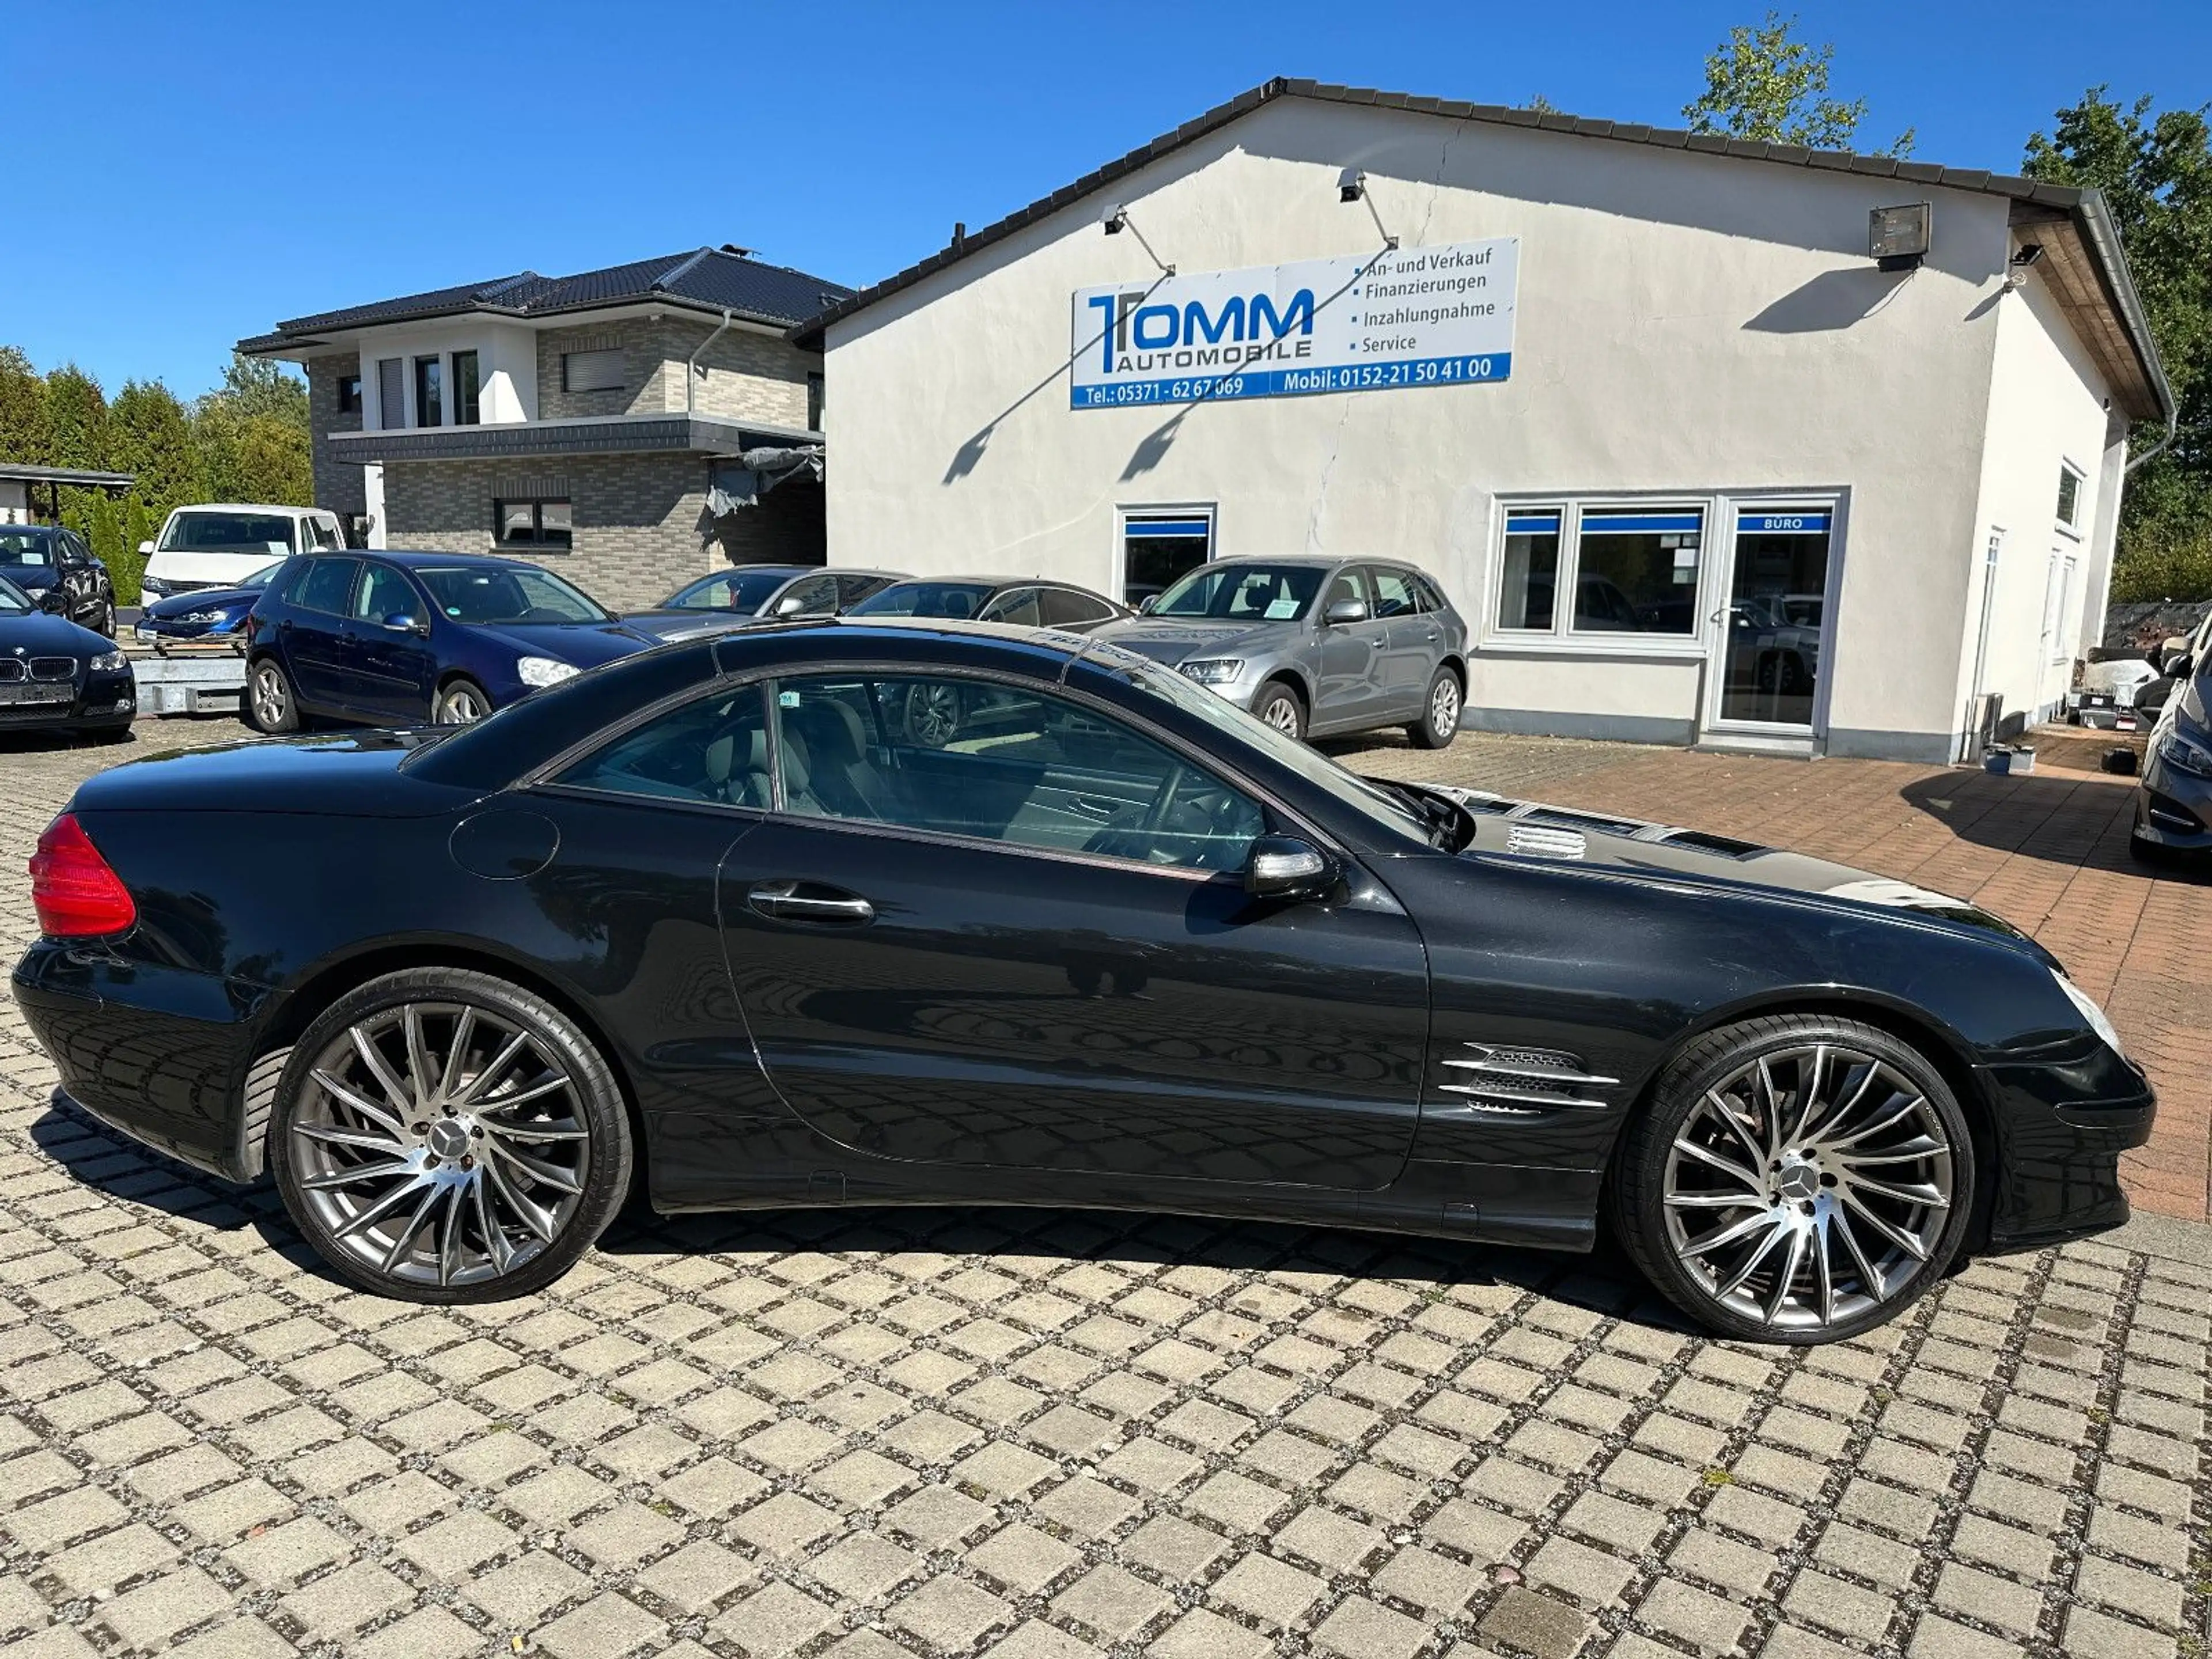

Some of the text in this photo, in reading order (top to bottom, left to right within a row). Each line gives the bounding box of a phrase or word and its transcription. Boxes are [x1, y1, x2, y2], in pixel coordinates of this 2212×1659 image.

[1366, 248, 1493, 276] An- und Verkauf
[1366, 275, 1486, 299] Finanzierungen
[1364, 302, 1495, 327] Inzahlungnahme
[1089, 289, 1314, 373] TOMM
[1362, 335, 1416, 353] Service
[1117, 340, 1312, 373] AUTOMOBILE
[1284, 358, 1491, 391] Mobil: 0152-21 50 41 00
[1086, 387, 1115, 403] Tel.:
[1117, 383, 1160, 402] 05371
[1215, 377, 1244, 395] 069
[1764, 516, 1802, 529] BÜRO
